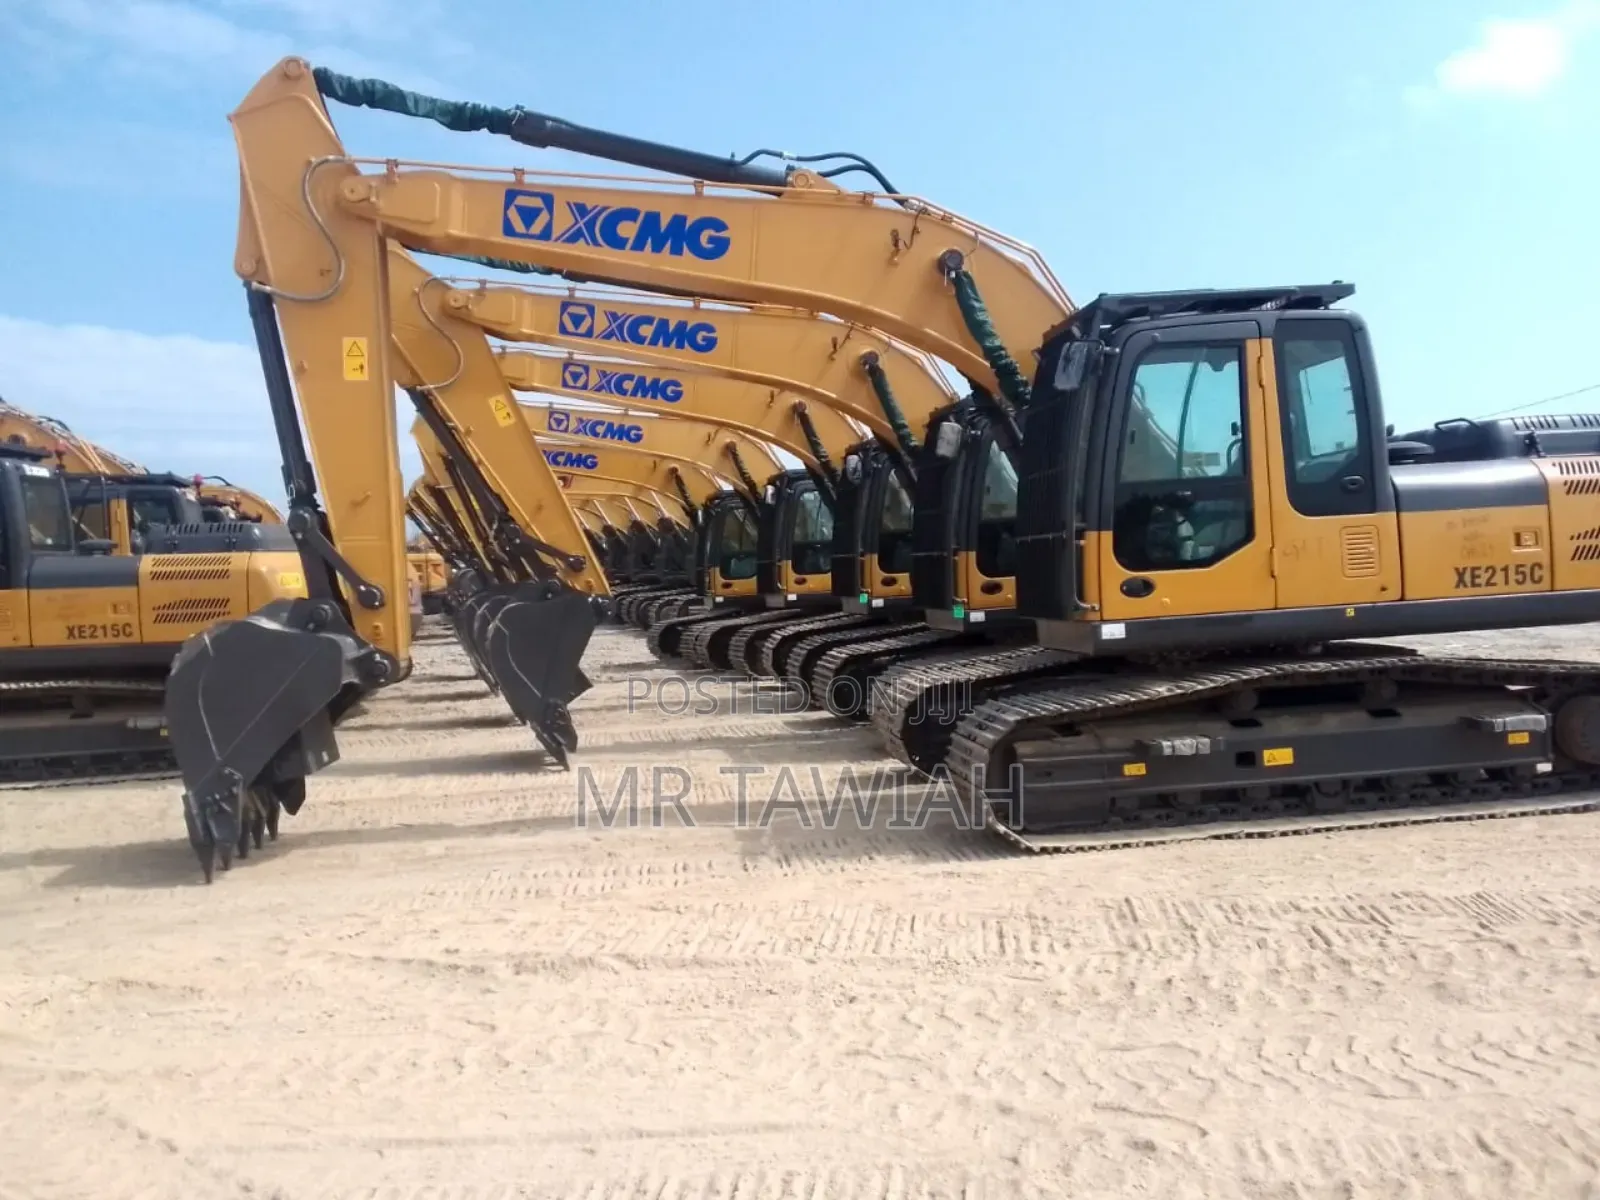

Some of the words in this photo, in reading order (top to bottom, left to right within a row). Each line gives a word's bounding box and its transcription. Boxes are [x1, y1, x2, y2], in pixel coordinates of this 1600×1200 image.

[554, 201, 730, 260] XCMG
[595, 310, 718, 353] XCMG
[589, 370, 683, 403] XCMG
[570, 417, 643, 443] XCMG
[1454, 562, 1544, 589] XE215C
[66, 623, 133, 640] XE215C
